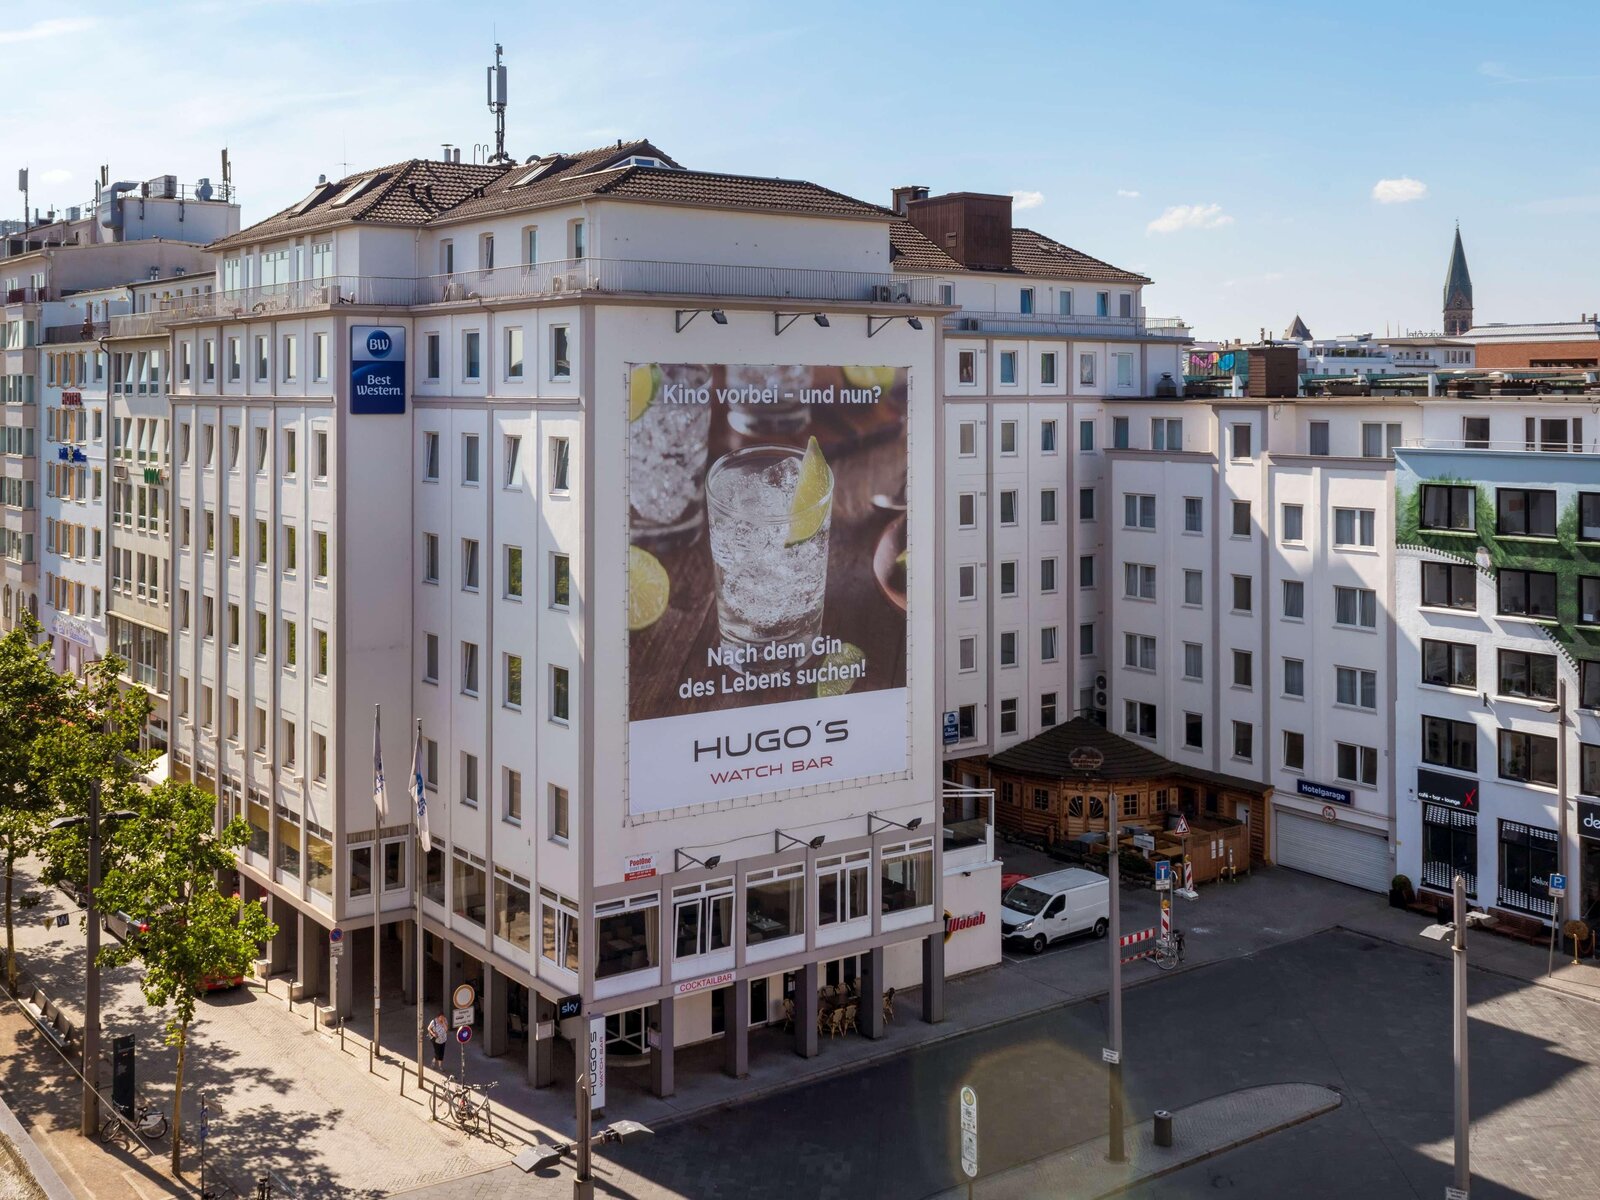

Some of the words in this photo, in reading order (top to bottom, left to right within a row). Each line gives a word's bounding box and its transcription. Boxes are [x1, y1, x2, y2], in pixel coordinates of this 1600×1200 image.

[369, 339, 389, 350] BW
[367, 374, 391, 385] Best
[356, 385, 400, 396] Western
[663, 384, 709, 404] Kino
[716, 384, 779, 404] vorbei
[800, 384, 833, 404] und
[840, 385, 882, 404] nun?
[707, 643, 757, 667] Nach
[763, 640, 805, 661] dem
[811, 635, 842, 656] Gin
[679, 678, 715, 699] des
[721, 671, 791, 694] Lebens
[796, 659, 866, 685] suchen!
[710, 763, 783, 784] WATCH
[792, 756, 833, 772] BAR
[1302, 784, 1346, 800] Hotelgarage
[680, 973, 733, 992] COCKTAILBAR
[561, 1002, 579, 1013] sky
